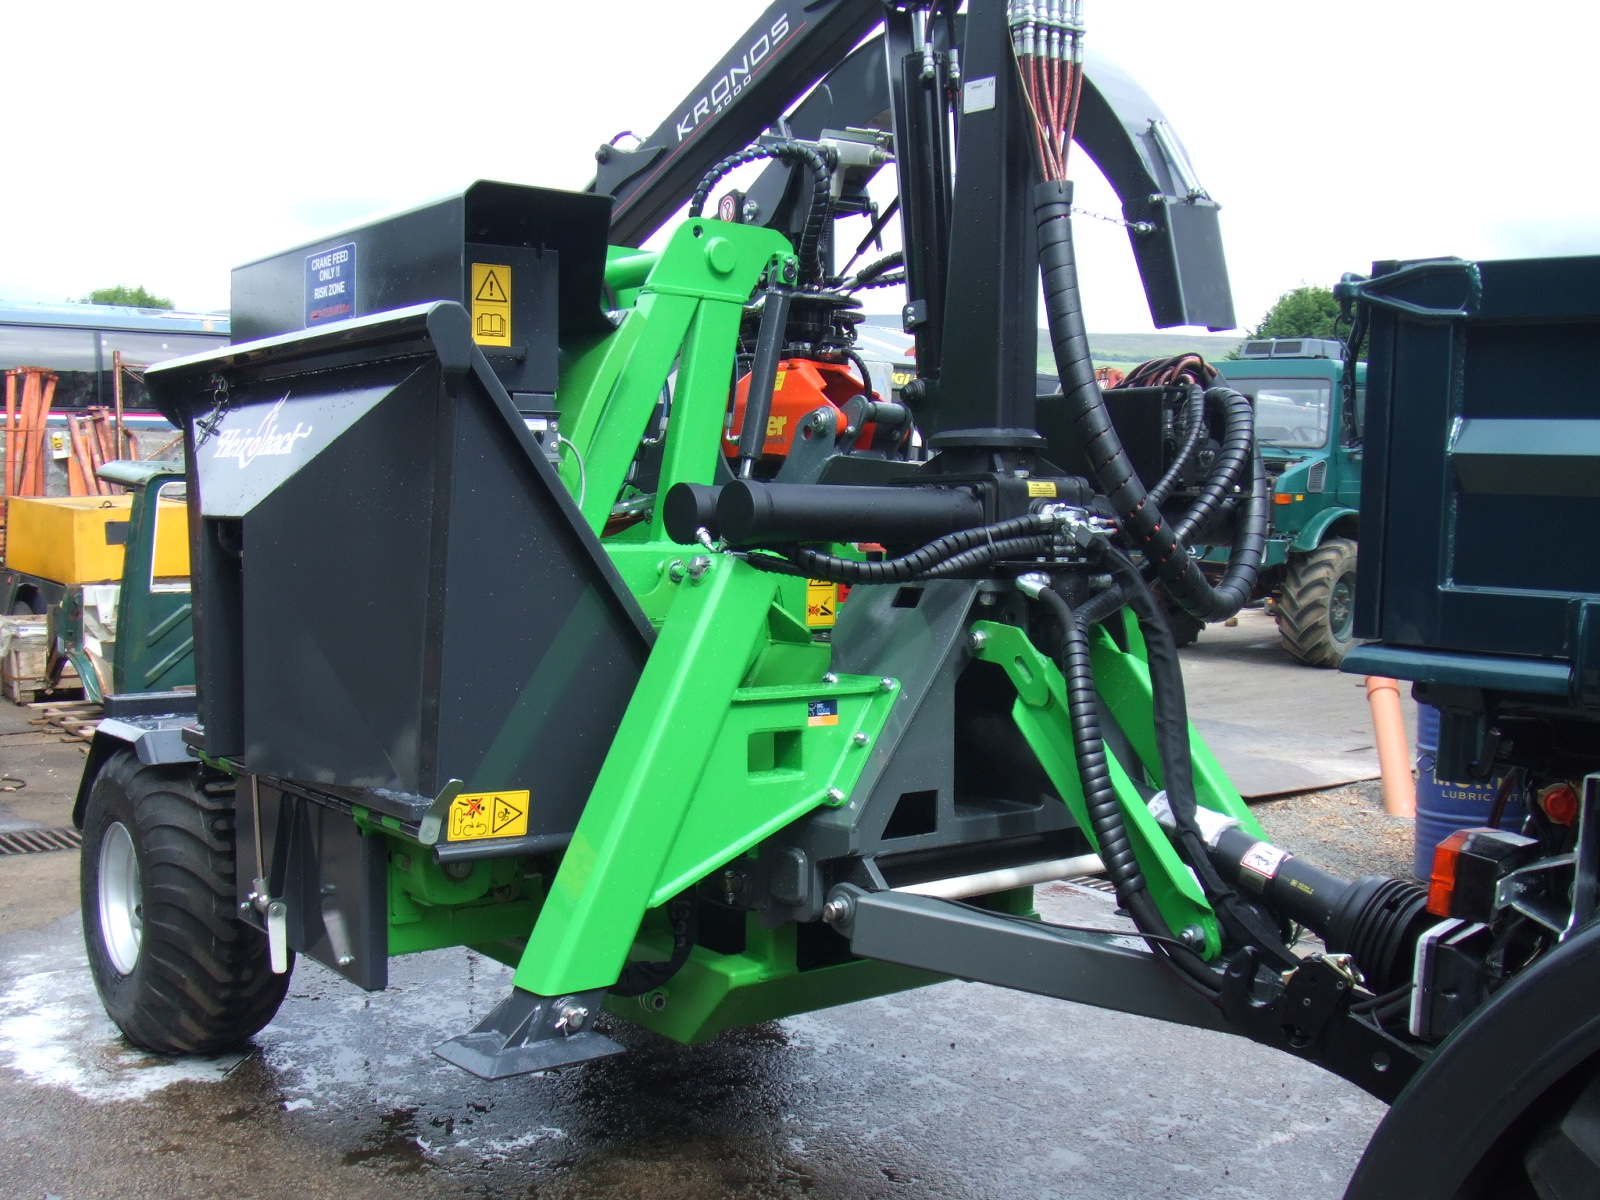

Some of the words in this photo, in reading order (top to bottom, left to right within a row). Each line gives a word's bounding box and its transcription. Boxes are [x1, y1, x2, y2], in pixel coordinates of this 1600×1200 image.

[676, 13, 789, 142] KRONOS
[715, 74, 751, 114] 4000
[311, 254, 332, 271] CRANE
[332, 249, 349, 265] FEED
[319, 267, 335, 281] ONLY
[314, 286, 328, 300] RISK
[328, 281, 345, 296] ZONE
